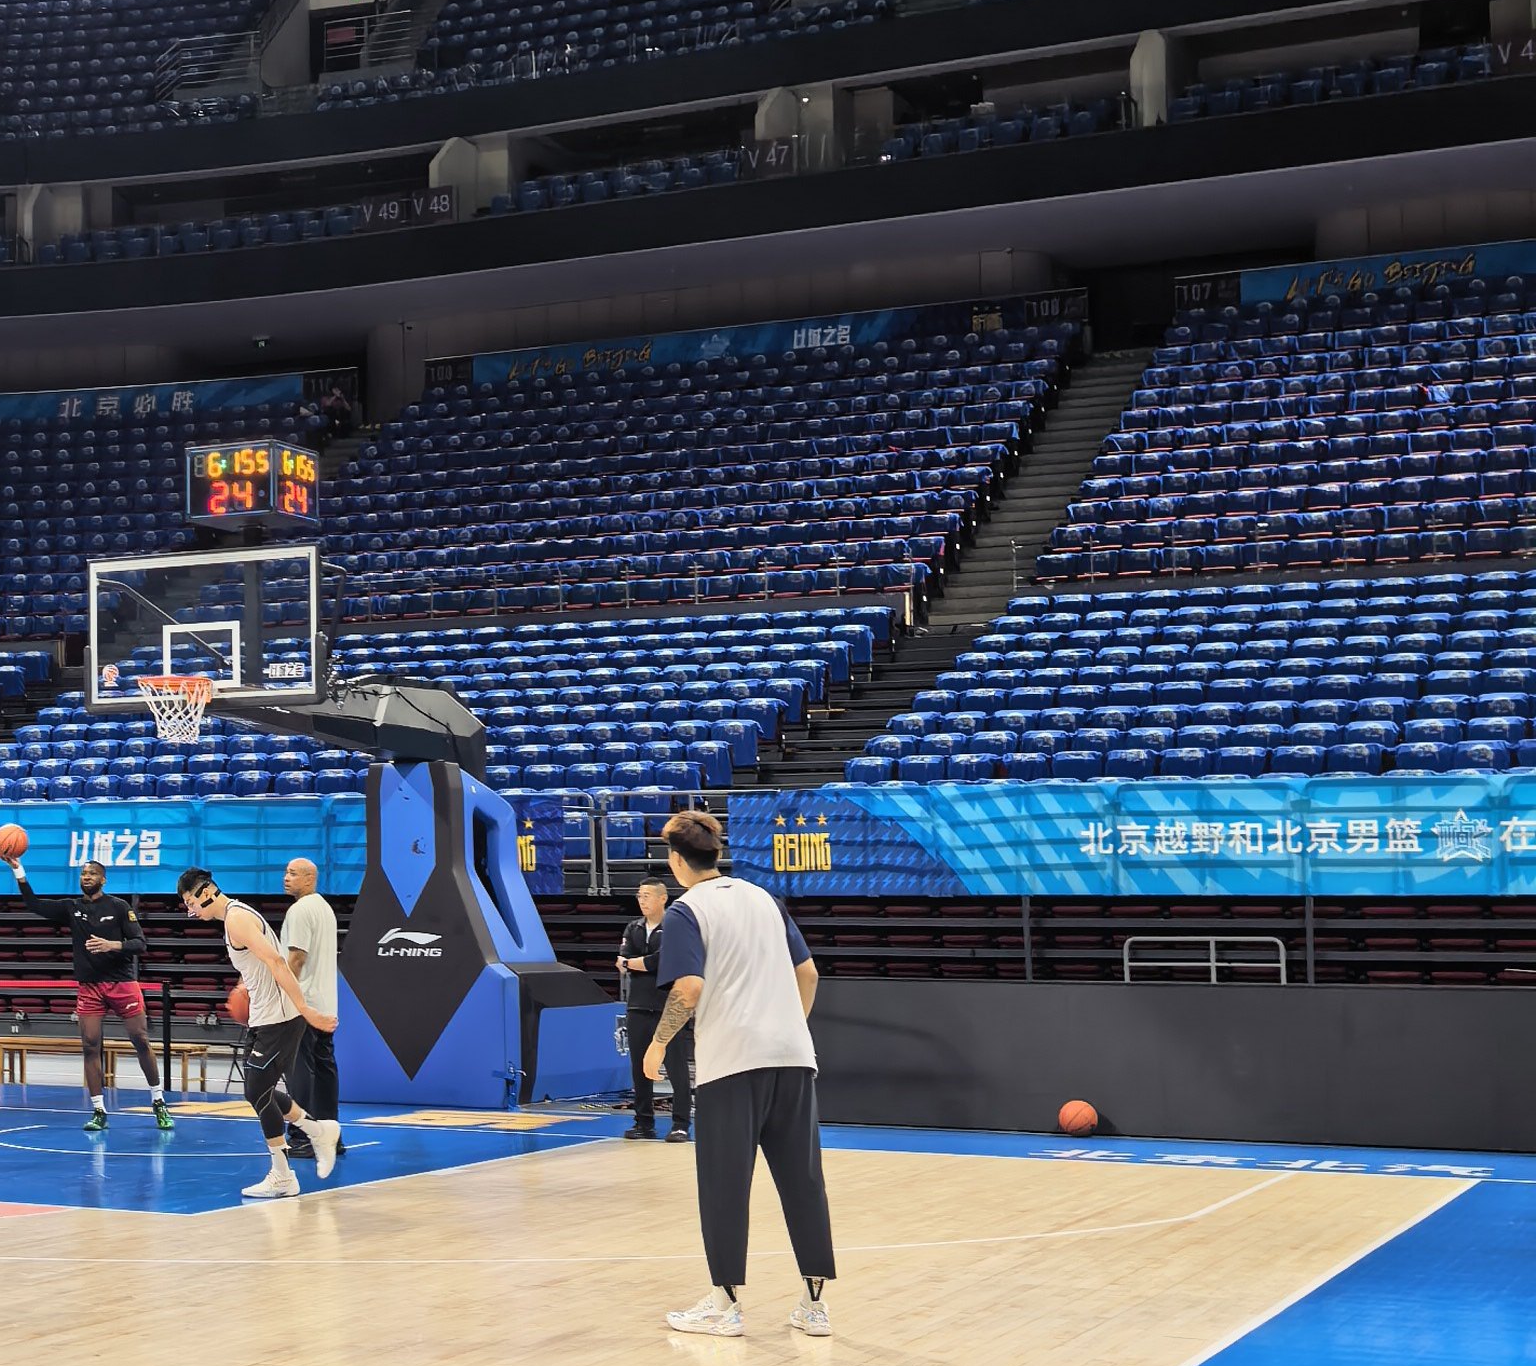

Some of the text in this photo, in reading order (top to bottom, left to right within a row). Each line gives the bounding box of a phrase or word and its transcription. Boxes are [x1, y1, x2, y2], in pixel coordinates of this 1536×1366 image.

[208, 480, 254, 515] 24
[283, 480, 308, 514] 24
[69, 828, 163, 868] 以城之名
[1080, 817, 1424, 857] 北京越野和北京男篮
[377, 947, 443, 957] LI-NING
